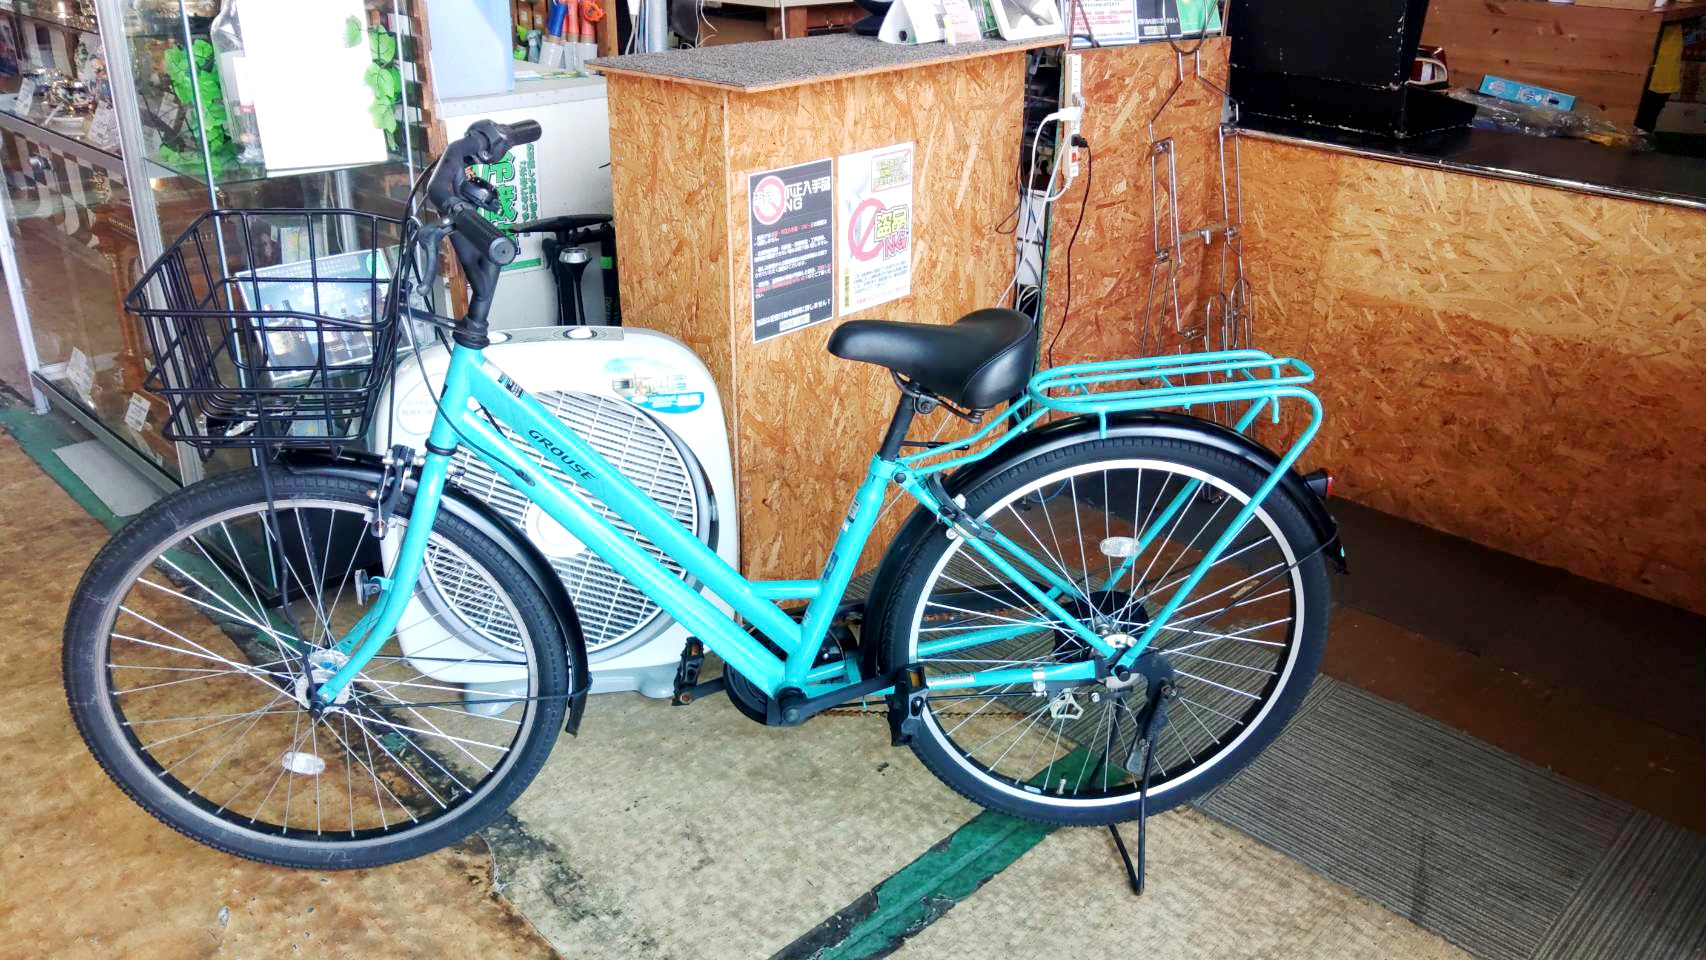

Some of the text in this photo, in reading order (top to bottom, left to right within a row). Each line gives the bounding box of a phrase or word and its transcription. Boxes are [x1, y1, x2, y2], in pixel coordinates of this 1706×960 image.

[784, 197, 803, 212] NG
[876, 208, 907, 239] 盗品
[884, 230, 909, 258] NG
[528, 430, 597, 480] GROUSE
